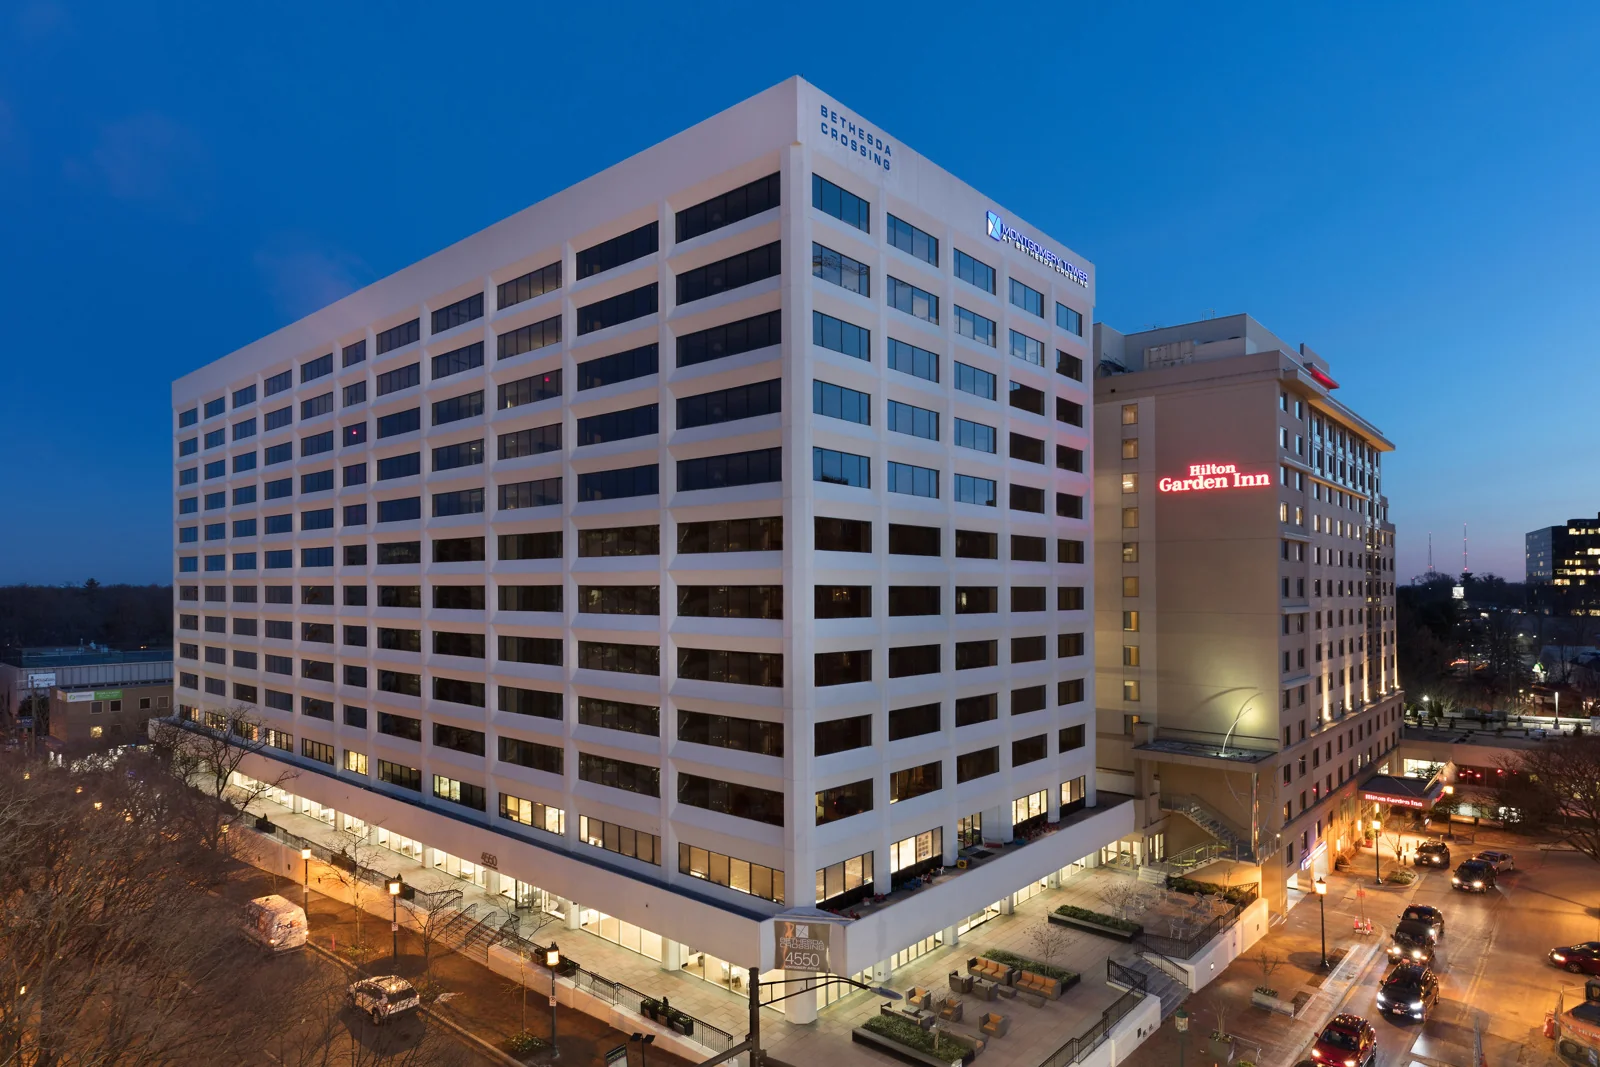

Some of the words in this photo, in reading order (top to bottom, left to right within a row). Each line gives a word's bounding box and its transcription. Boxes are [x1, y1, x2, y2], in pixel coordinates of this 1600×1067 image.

[821, 104, 891, 157] BETHESDA
[821, 122, 890, 171] CROSSING
[1001, 223, 1061, 265] MONTGOMERY
[1062, 260, 1088, 282] TOWER
[1001, 234, 1012, 244] AT
[1014, 241, 1053, 268] BETHESDA
[1055, 265, 1089, 288] CROSSING
[1159, 475, 1228, 492] Garden
[1233, 472, 1270, 487] Inn
[1189, 464, 1236, 476] Hilton
[780, 937, 824, 945] BETHESDA
[785, 951, 820, 967] 4550
